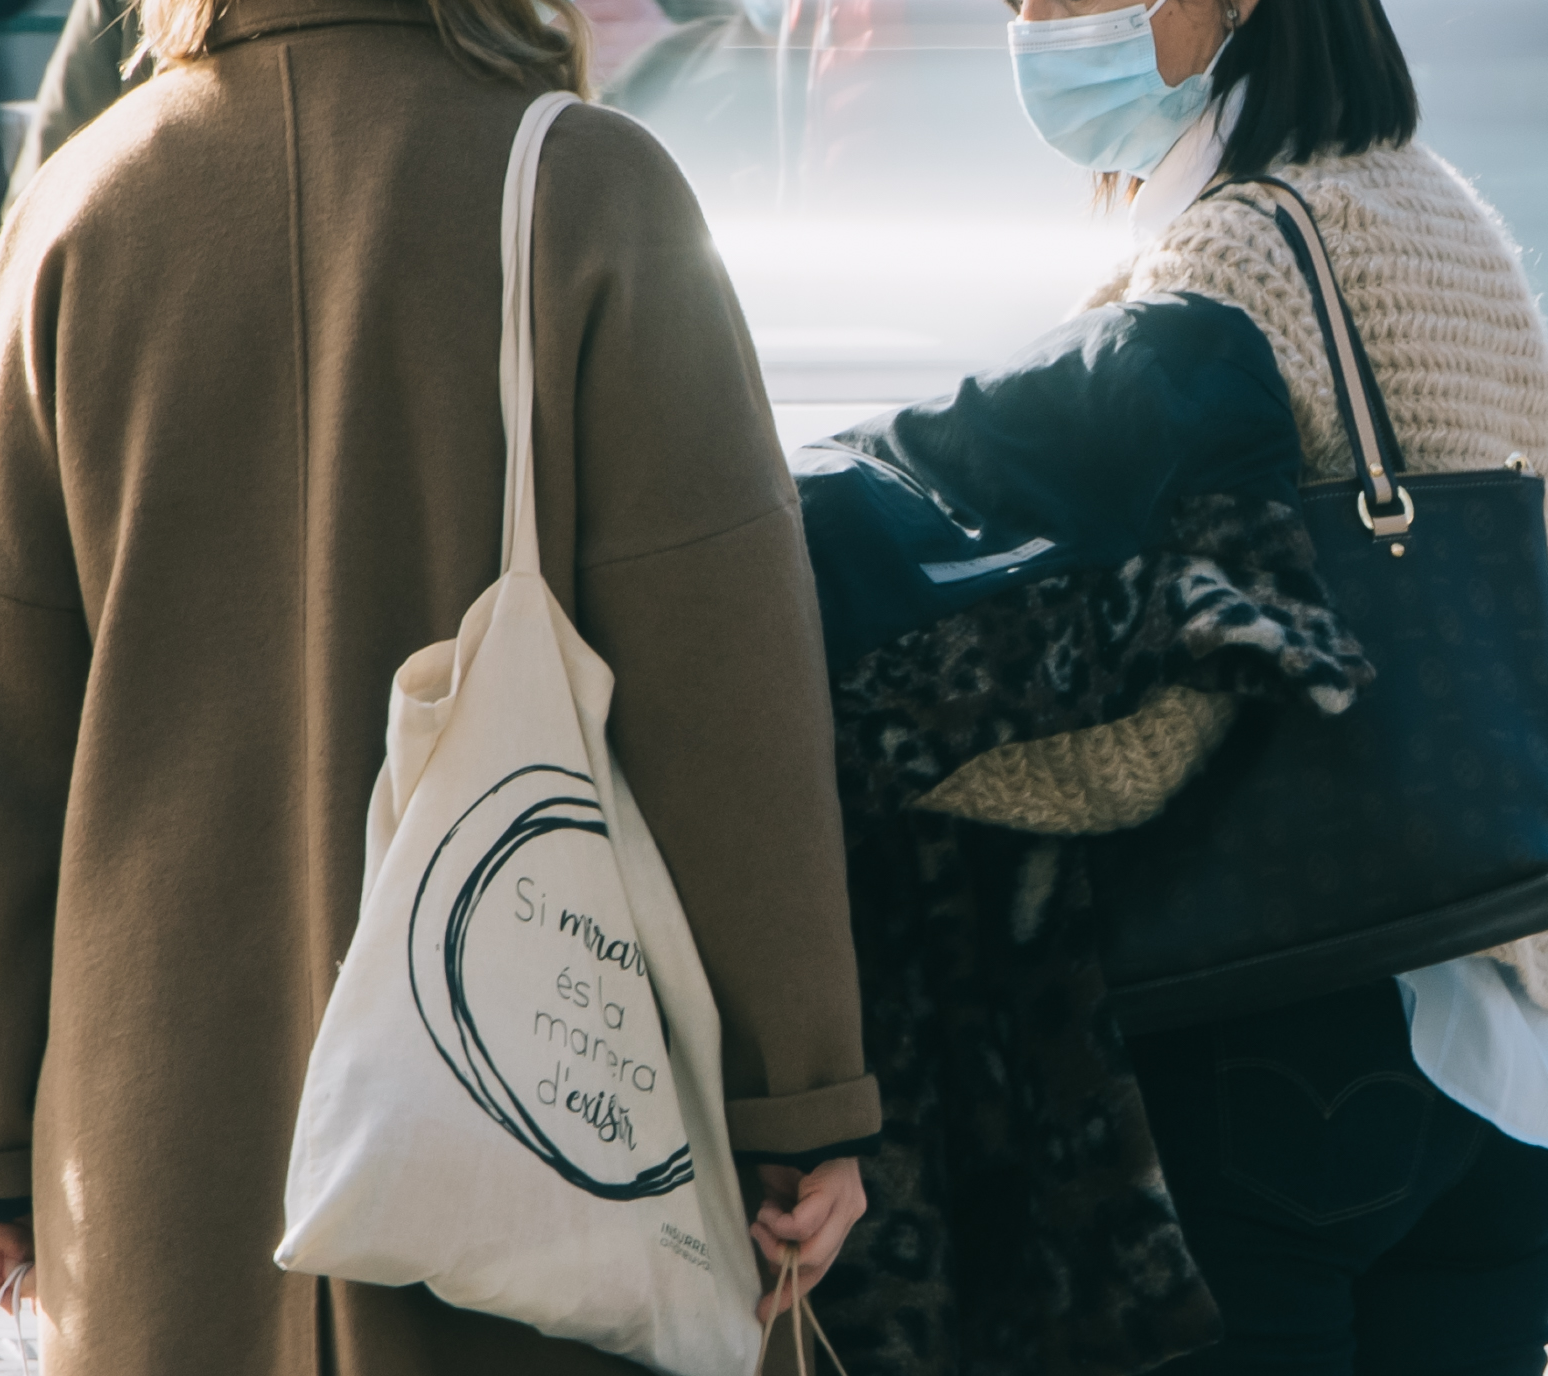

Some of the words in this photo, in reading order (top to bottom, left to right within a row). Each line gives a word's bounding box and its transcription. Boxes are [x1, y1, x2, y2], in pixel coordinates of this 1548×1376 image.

[515, 876, 546, 927] Si
[556, 966, 591, 1008] és
[598, 975, 626, 1031] la
